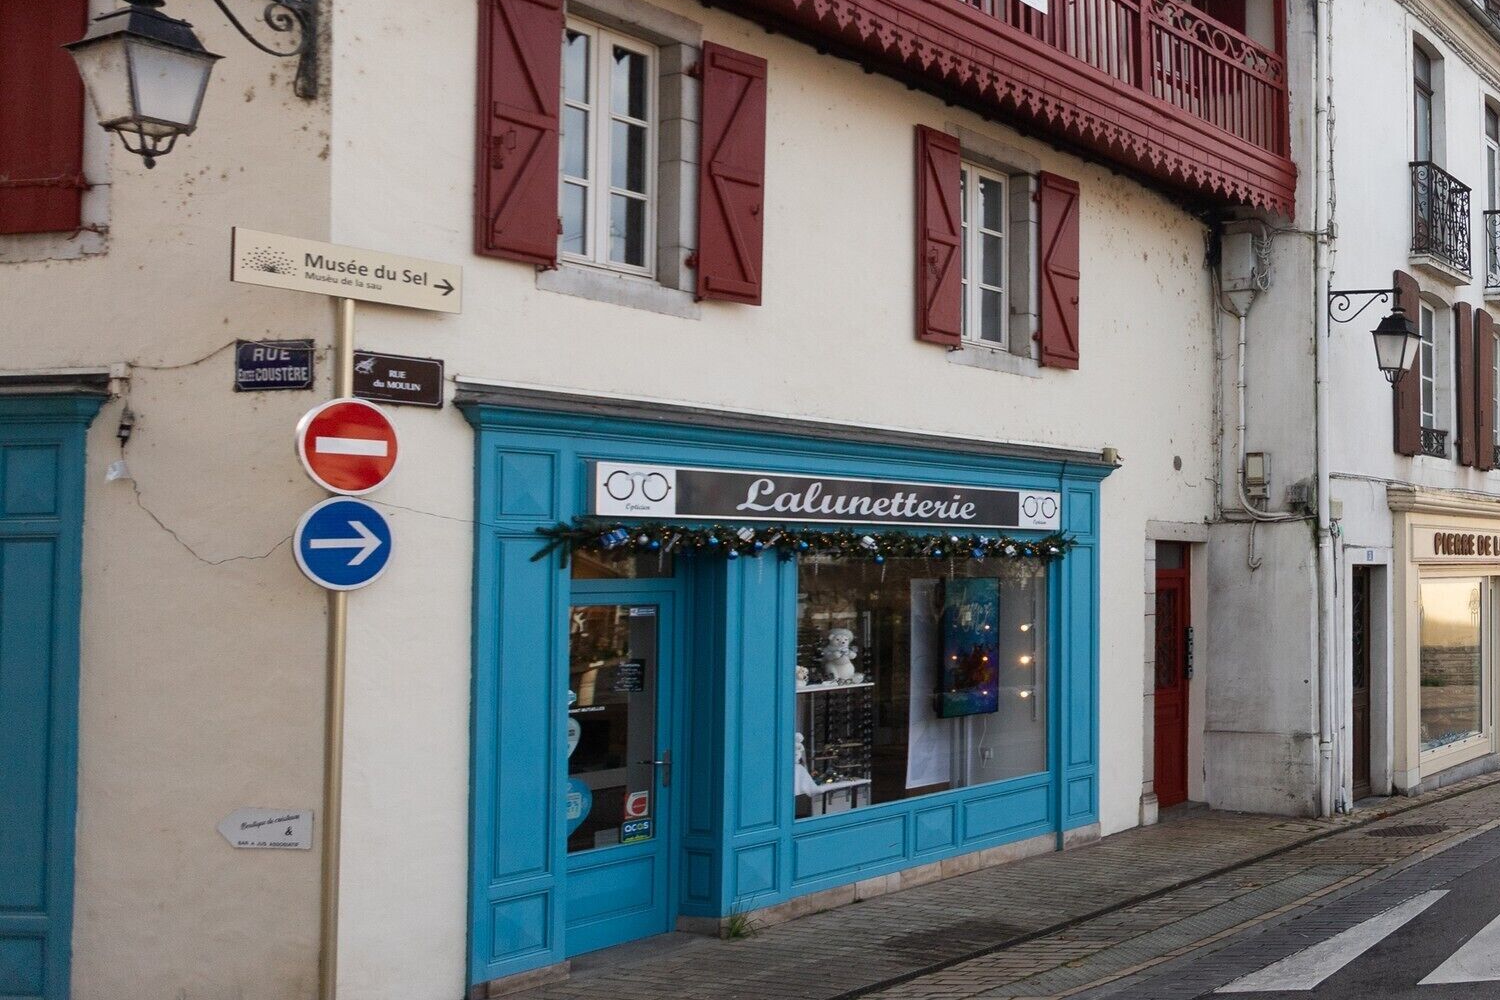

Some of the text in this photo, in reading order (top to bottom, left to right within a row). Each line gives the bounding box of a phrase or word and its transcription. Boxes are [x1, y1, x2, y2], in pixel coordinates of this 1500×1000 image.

[304, 252, 427, 286] Musée du Sel
[341, 275, 353, 286] de
[355, 277, 365, 288] la
[366, 281, 383, 291] sau
[252, 348, 291, 361] RUE
[388, 369, 407, 379] RUE
[372, 379, 421, 391] du MOULIN
[736, 478, 976, 520] Lalunetterie
[1434, 532, 1475, 556] PIERRE
[1477, 534, 1491, 556] DE
[284, 825, 293, 836] &
